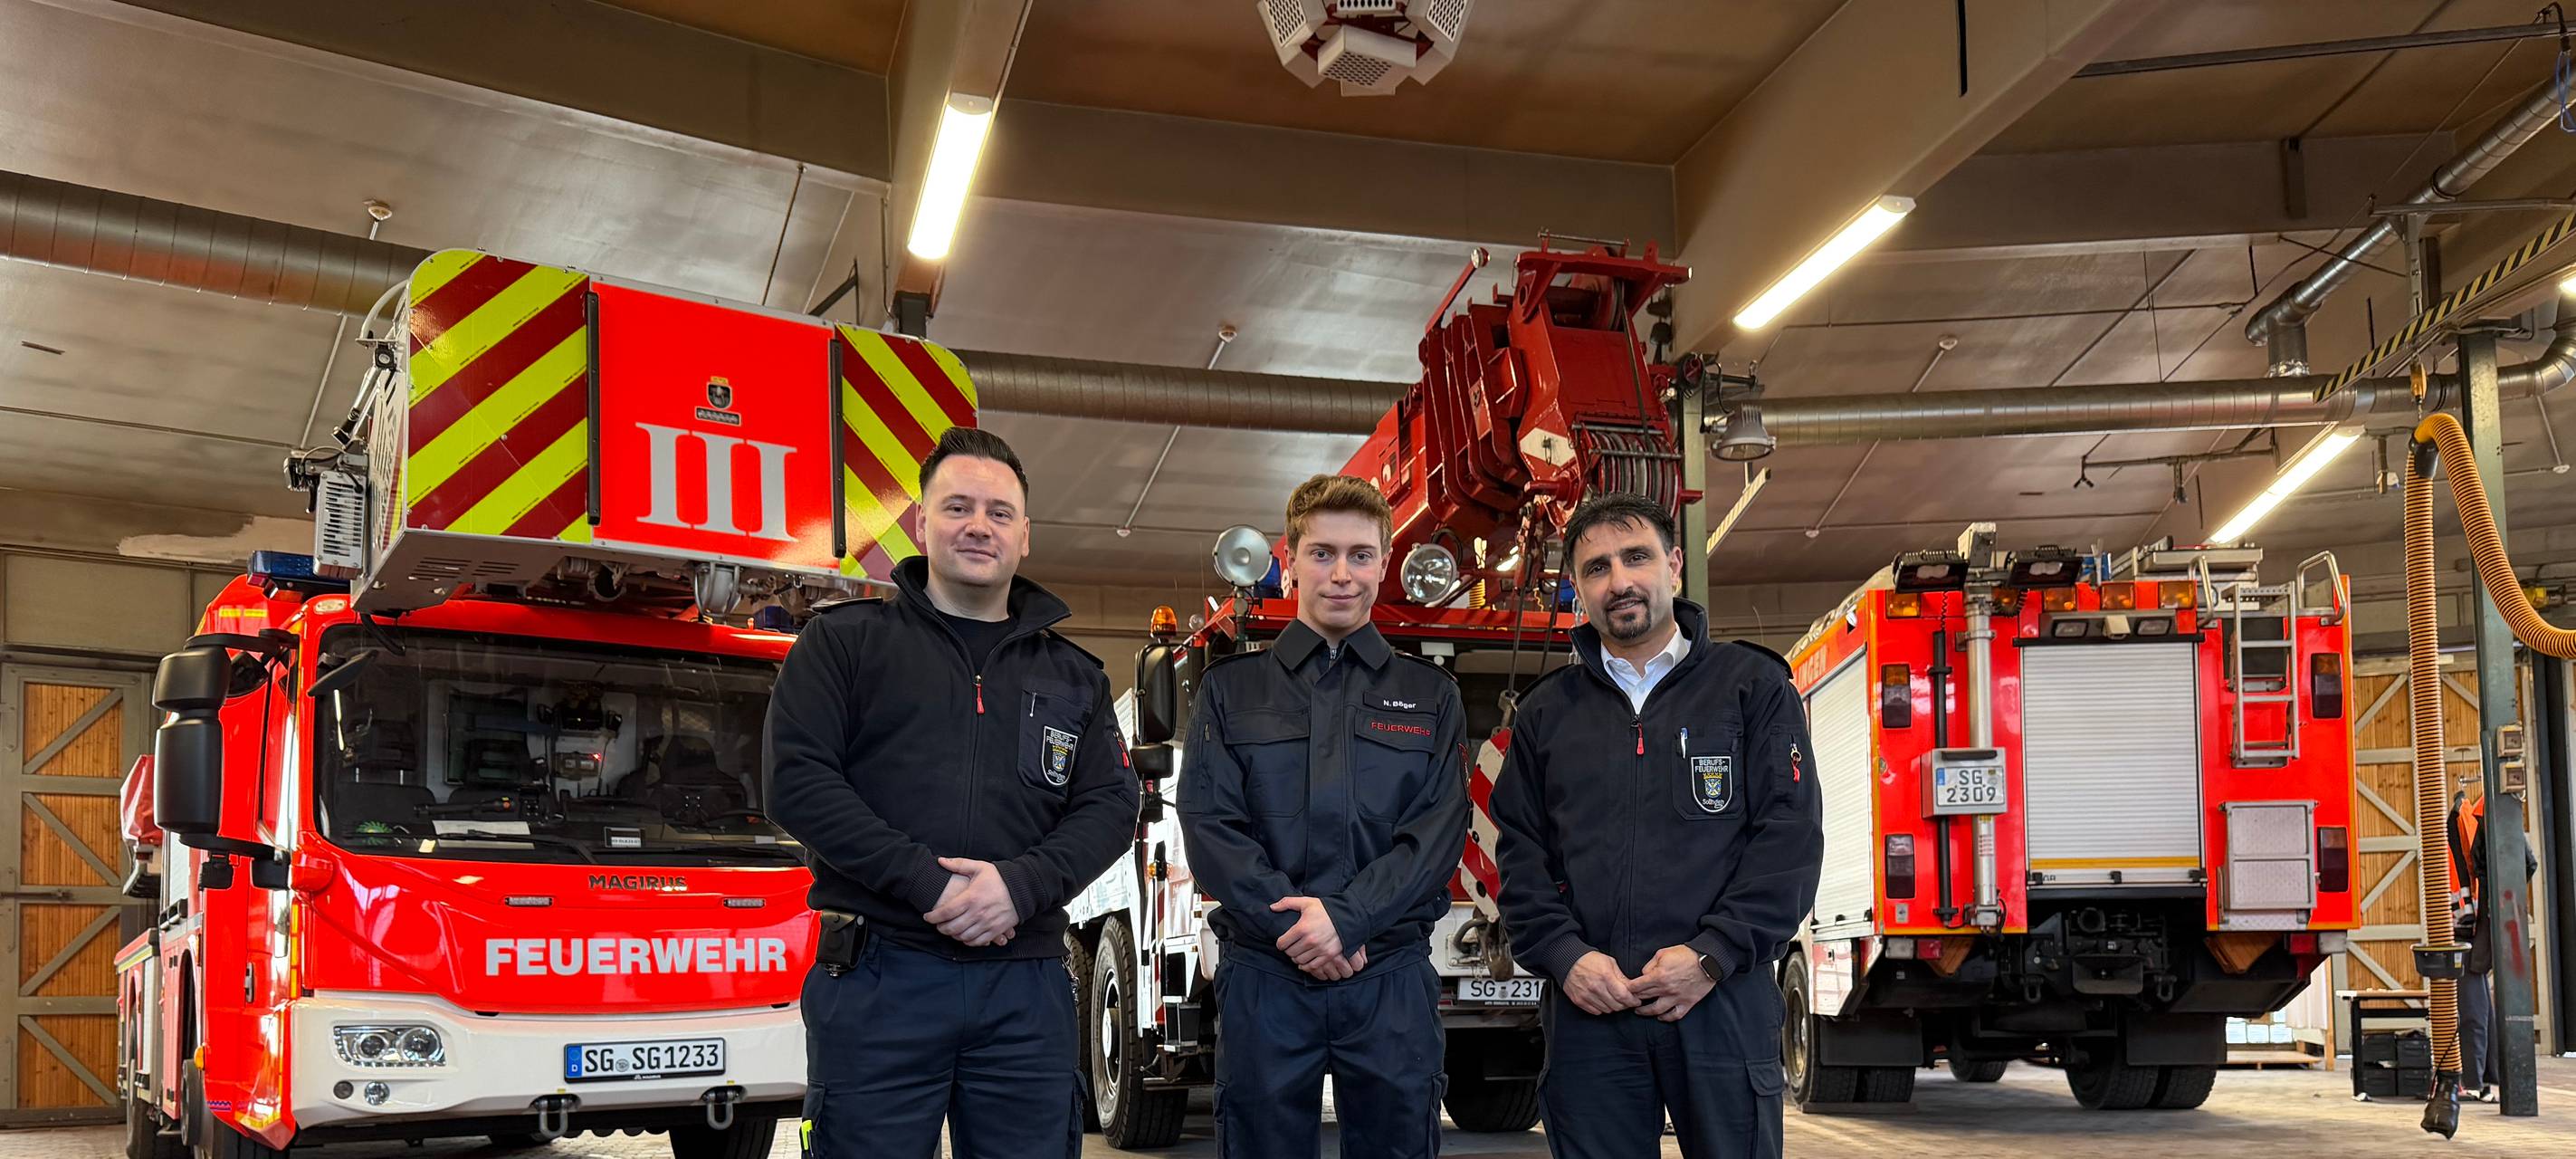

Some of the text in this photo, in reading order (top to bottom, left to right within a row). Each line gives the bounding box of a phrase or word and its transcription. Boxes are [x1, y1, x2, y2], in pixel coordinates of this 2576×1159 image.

[1371, 722, 1431, 736] FEUERWEHR
[1694, 765, 1729, 773] FEUERWEHR
[1959, 770, 1983, 785] SG
[1946, 786, 1997, 803] 2309
[588, 874, 688, 891] MAGIRUS
[486, 937, 788, 977] FEUERWEHR
[585, 1049, 615, 1073] SG
